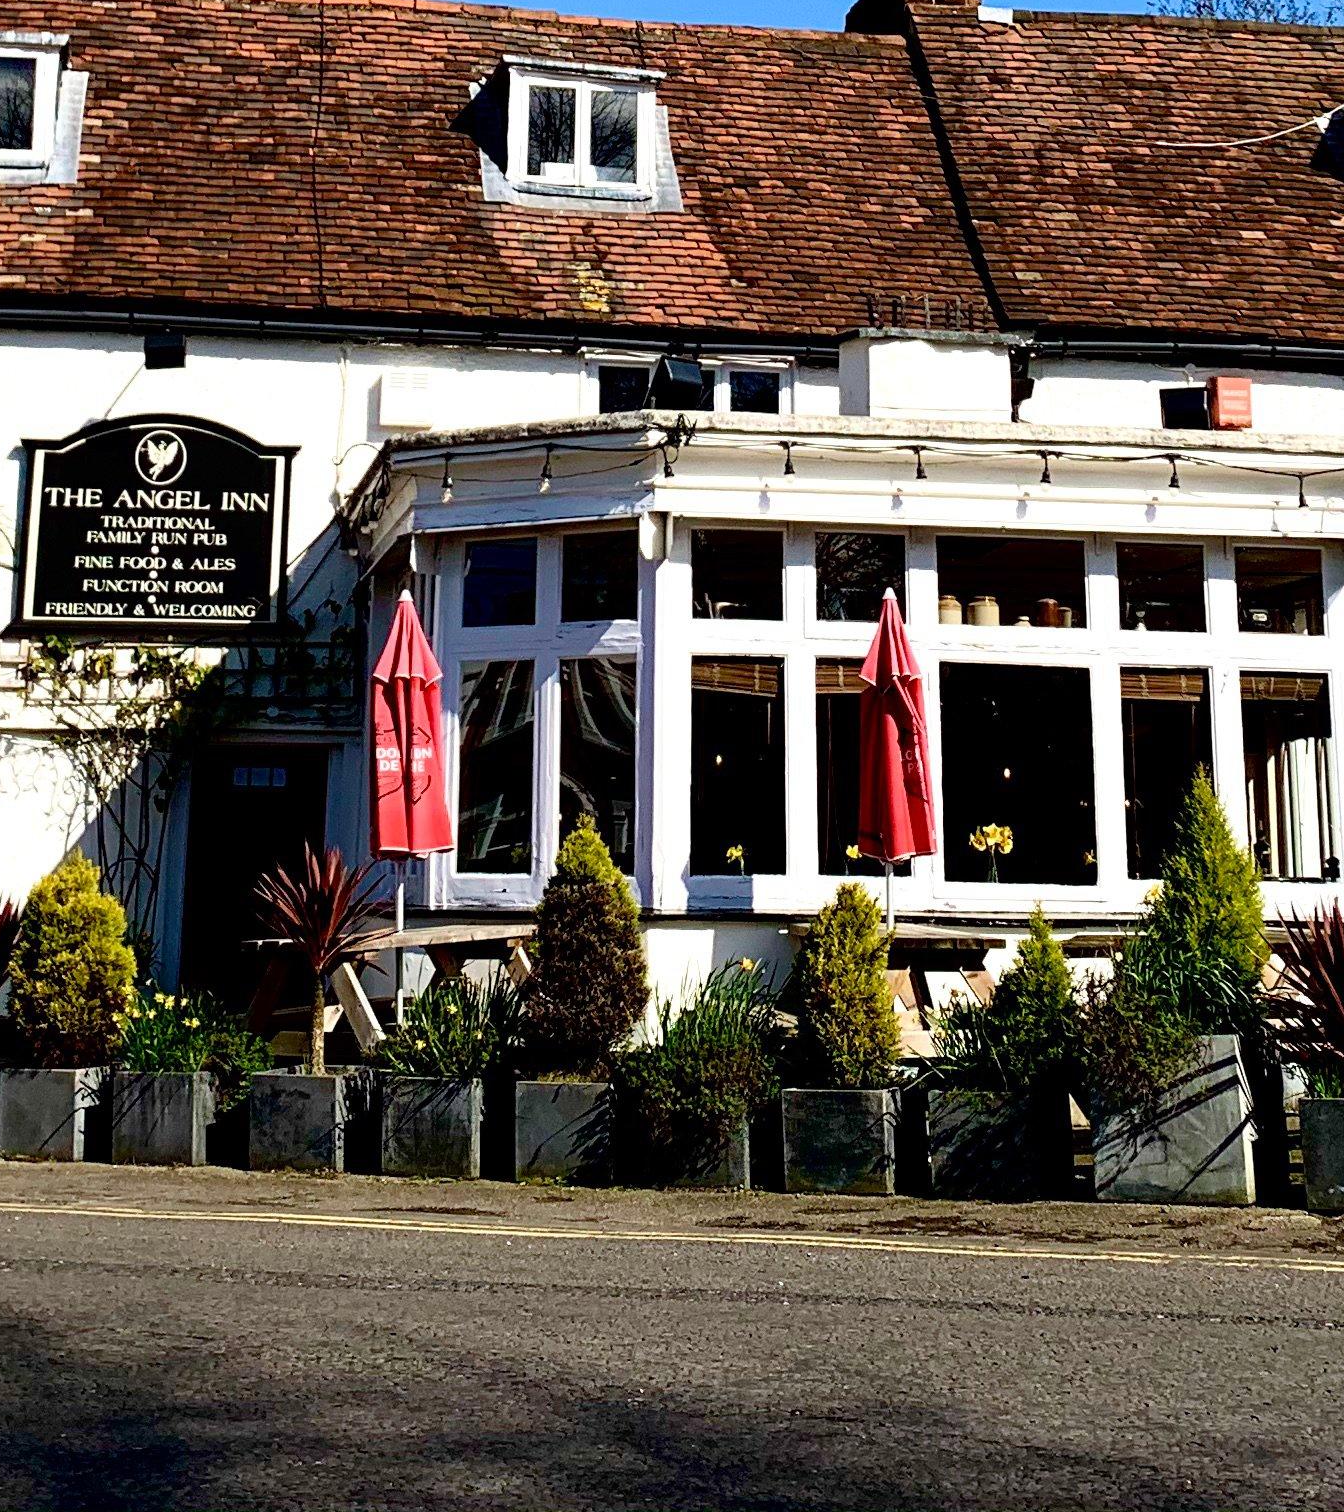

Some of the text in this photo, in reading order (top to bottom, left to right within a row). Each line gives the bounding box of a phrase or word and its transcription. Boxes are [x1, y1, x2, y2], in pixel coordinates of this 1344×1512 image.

[44, 488, 269, 512] THE ANGEL INN
[100, 515, 215, 530] TRADITIONAL
[86, 531, 227, 546] FAMILY RUN PUB
[74, 556, 236, 570] FINE FOOD & ALES
[82, 580, 224, 594] FUNCTION ROOM
[45, 602, 256, 618] FRIENDLY & WELCOMING
